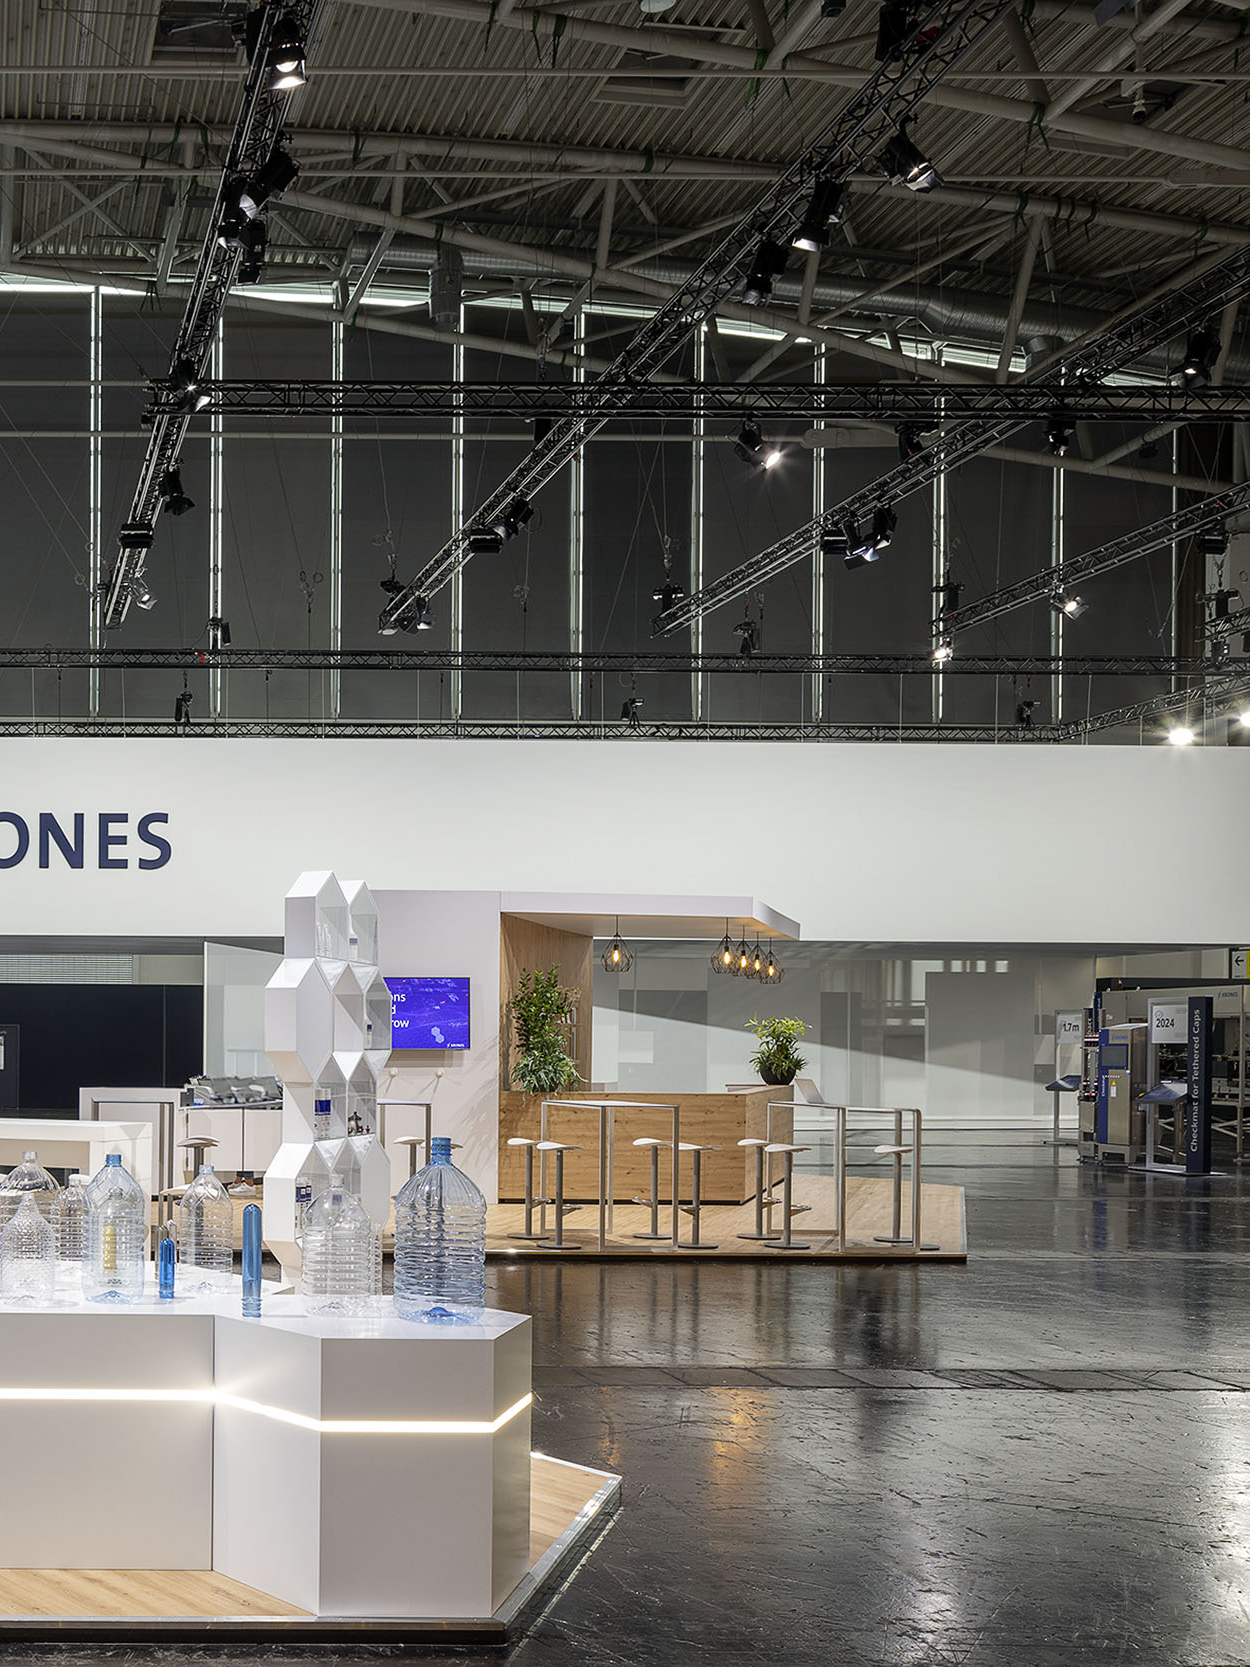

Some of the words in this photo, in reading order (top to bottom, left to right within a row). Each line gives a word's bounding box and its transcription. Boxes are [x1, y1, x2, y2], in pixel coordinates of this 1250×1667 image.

[1155, 1018, 1175, 1028] 2024
[1192, 1009, 1202, 1033] Caps
[1191, 1036, 1200, 1081] Tethered
[1191, 1083, 1200, 1099] for
[1190, 1101, 1200, 1152] Checkmat
